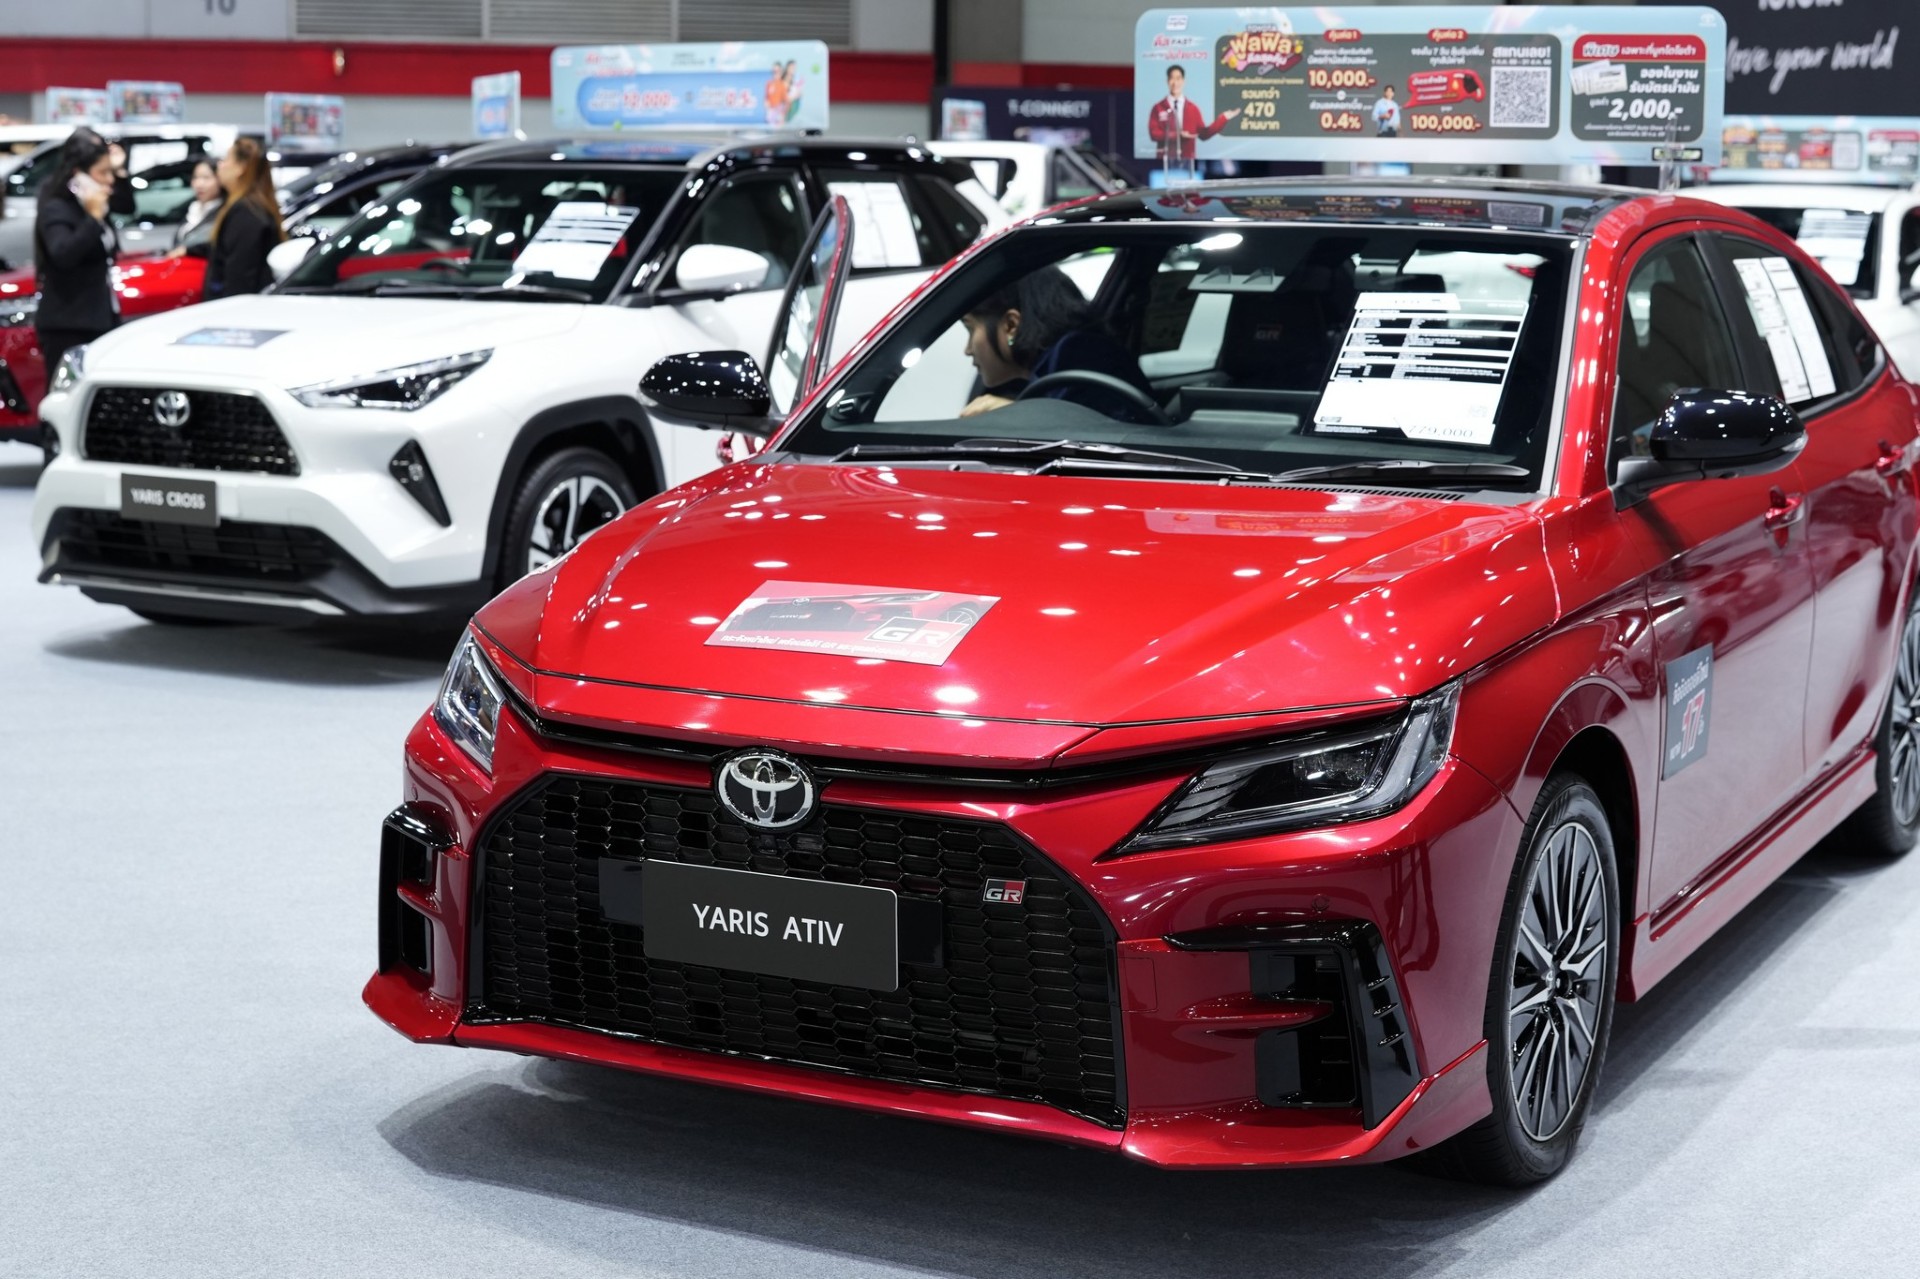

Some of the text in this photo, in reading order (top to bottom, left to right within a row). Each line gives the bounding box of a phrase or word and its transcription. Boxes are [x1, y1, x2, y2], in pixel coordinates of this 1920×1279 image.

[1492, 46, 1551, 58] สแกนเลย!
[1769, 46, 1830, 95] your
[1831, 25, 1900, 70] world
[1640, 65, 1699, 79] จองในงาน
[1241, 86, 1280, 99] รวมกว่า
[1629, 78, 1701, 94] รับบัตรน้ำมัน
[1006, 99, 1091, 118] T-CONNECT
[1244, 102, 1276, 117] 470
[1240, 118, 1280, 131] ล้านบาท
[1320, 111, 1362, 129] 0.4%
[130, 487, 206, 510] YARIS CROSS
[871, 626, 955, 646] GR
[1681, 688, 1706, 759] 17
[985, 886, 1022, 902] GR
[692, 902, 844, 947] YARIS ATIV
